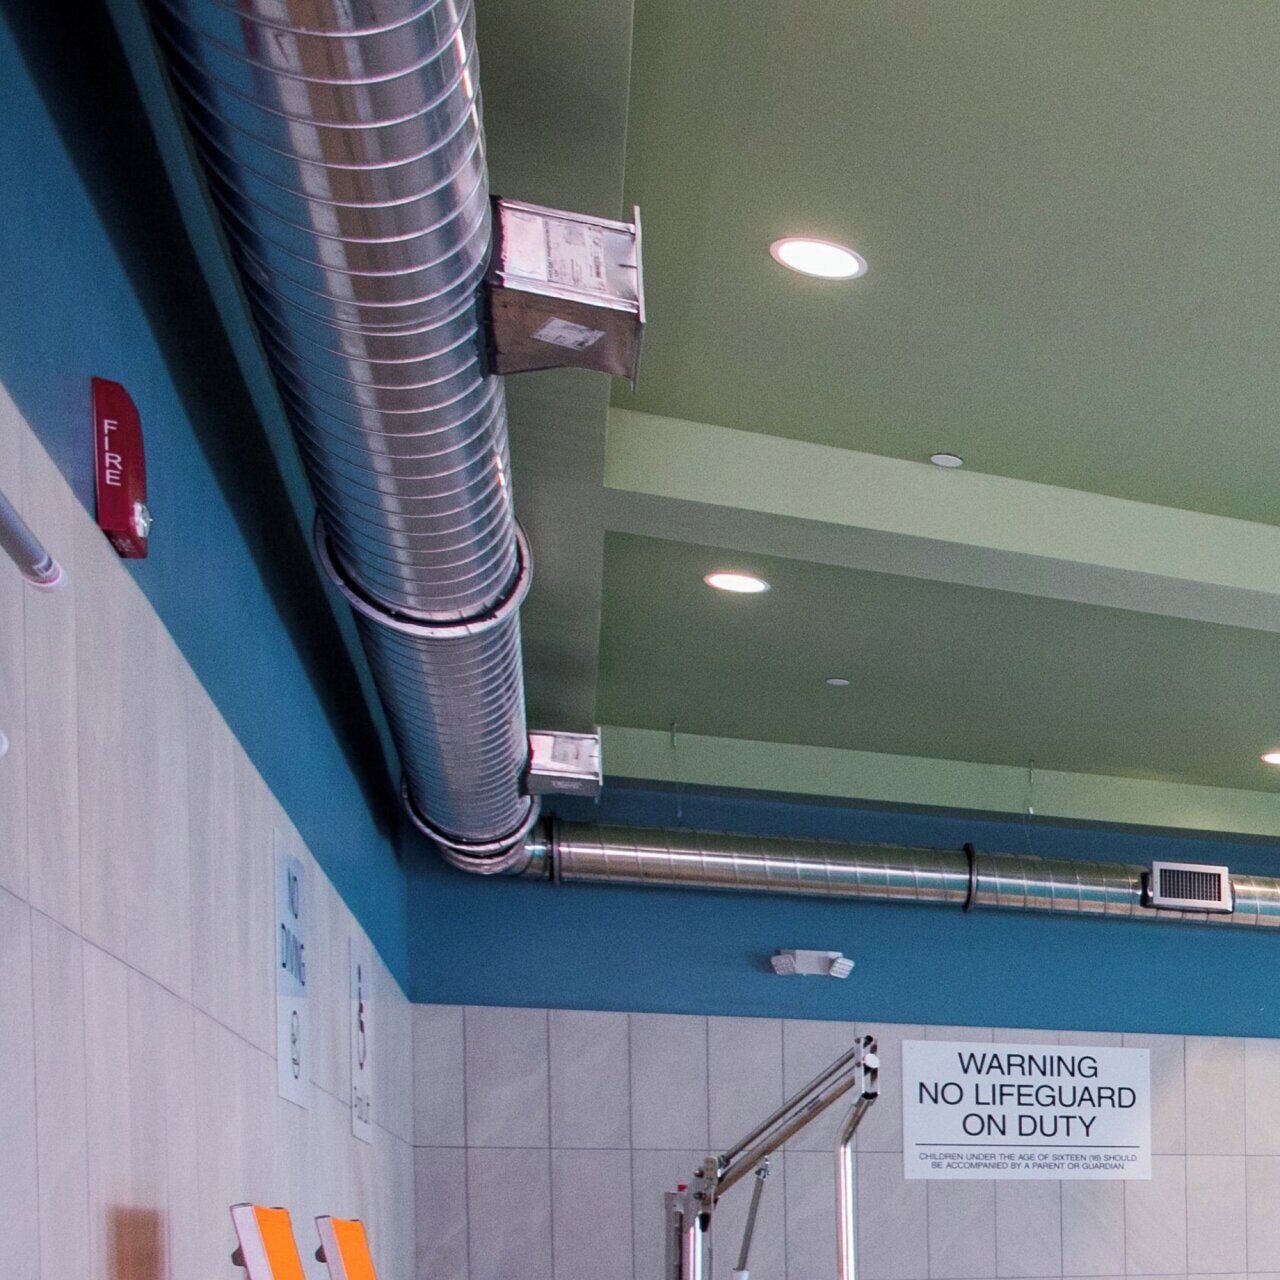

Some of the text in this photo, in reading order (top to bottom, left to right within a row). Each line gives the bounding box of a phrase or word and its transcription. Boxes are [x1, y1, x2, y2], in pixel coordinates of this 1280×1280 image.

[103, 419, 123, 487] FIRE
[957, 1052, 1098, 1079] WARNING
[918, 1081, 1137, 1109] NO LIFEGUARD
[962, 1113, 1097, 1138] ON DUTY
[918, 1152, 964, 1161] CHILDREN
[965, 1153, 998, 1161] UNDER
[999, 1153, 1016, 1161] THE
[1017, 1153, 1036, 1161] AGE
[1037, 1153, 1050, 1162] OF
[1051, 1153, 1087, 1162] SIXTEEN
[1103, 1153, 1137, 1162] SHOULD
[930, 1161, 943, 1169] BE
[945, 1161, 1009, 1170] ACCOMPANIED
[1010, 1162, 1022, 1170] BY
[1032, 1162, 1064, 1170] PARENT
[1067, 1162, 1081, 1170] OR
